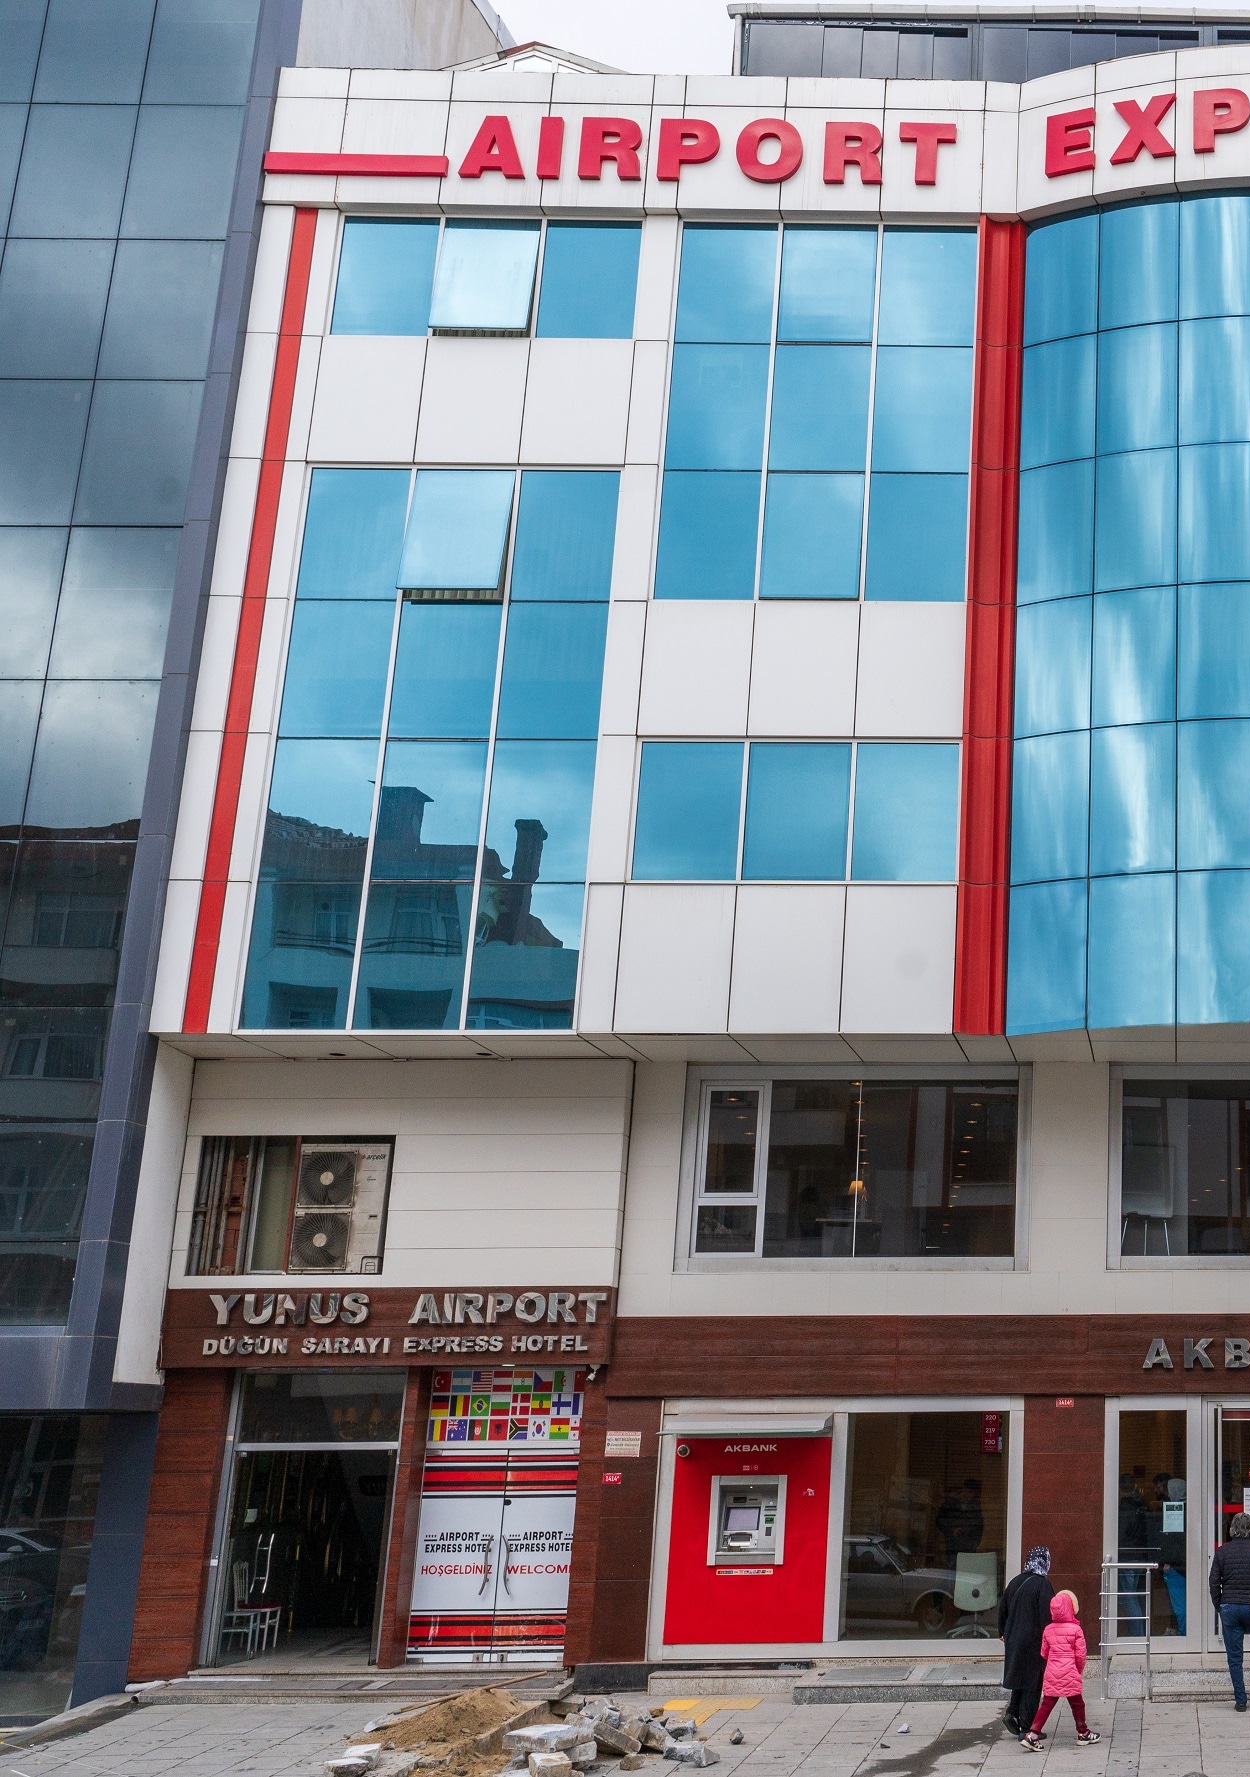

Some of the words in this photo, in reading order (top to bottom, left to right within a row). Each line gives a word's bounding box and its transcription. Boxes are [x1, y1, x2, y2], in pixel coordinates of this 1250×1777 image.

[458, 115, 957, 185] AIRPORT
[209, 1292, 370, 1325] YUNUS
[407, 1291, 607, 1324] AIRPORT
[202, 1335, 289, 1356] DÜĞÜN
[301, 1337, 391, 1354] SARAYI
[403, 1335, 504, 1353] EXPRESS
[511, 1335, 589, 1352] HOTEL
[724, 1444, 778, 1453] AKBANK
[439, 1531, 480, 1541] AIRPORT
[523, 1531, 564, 1541] AIRPORT
[424, 1543, 462, 1553] EXPRESS
[509, 1543, 547, 1552] EXPRESS
